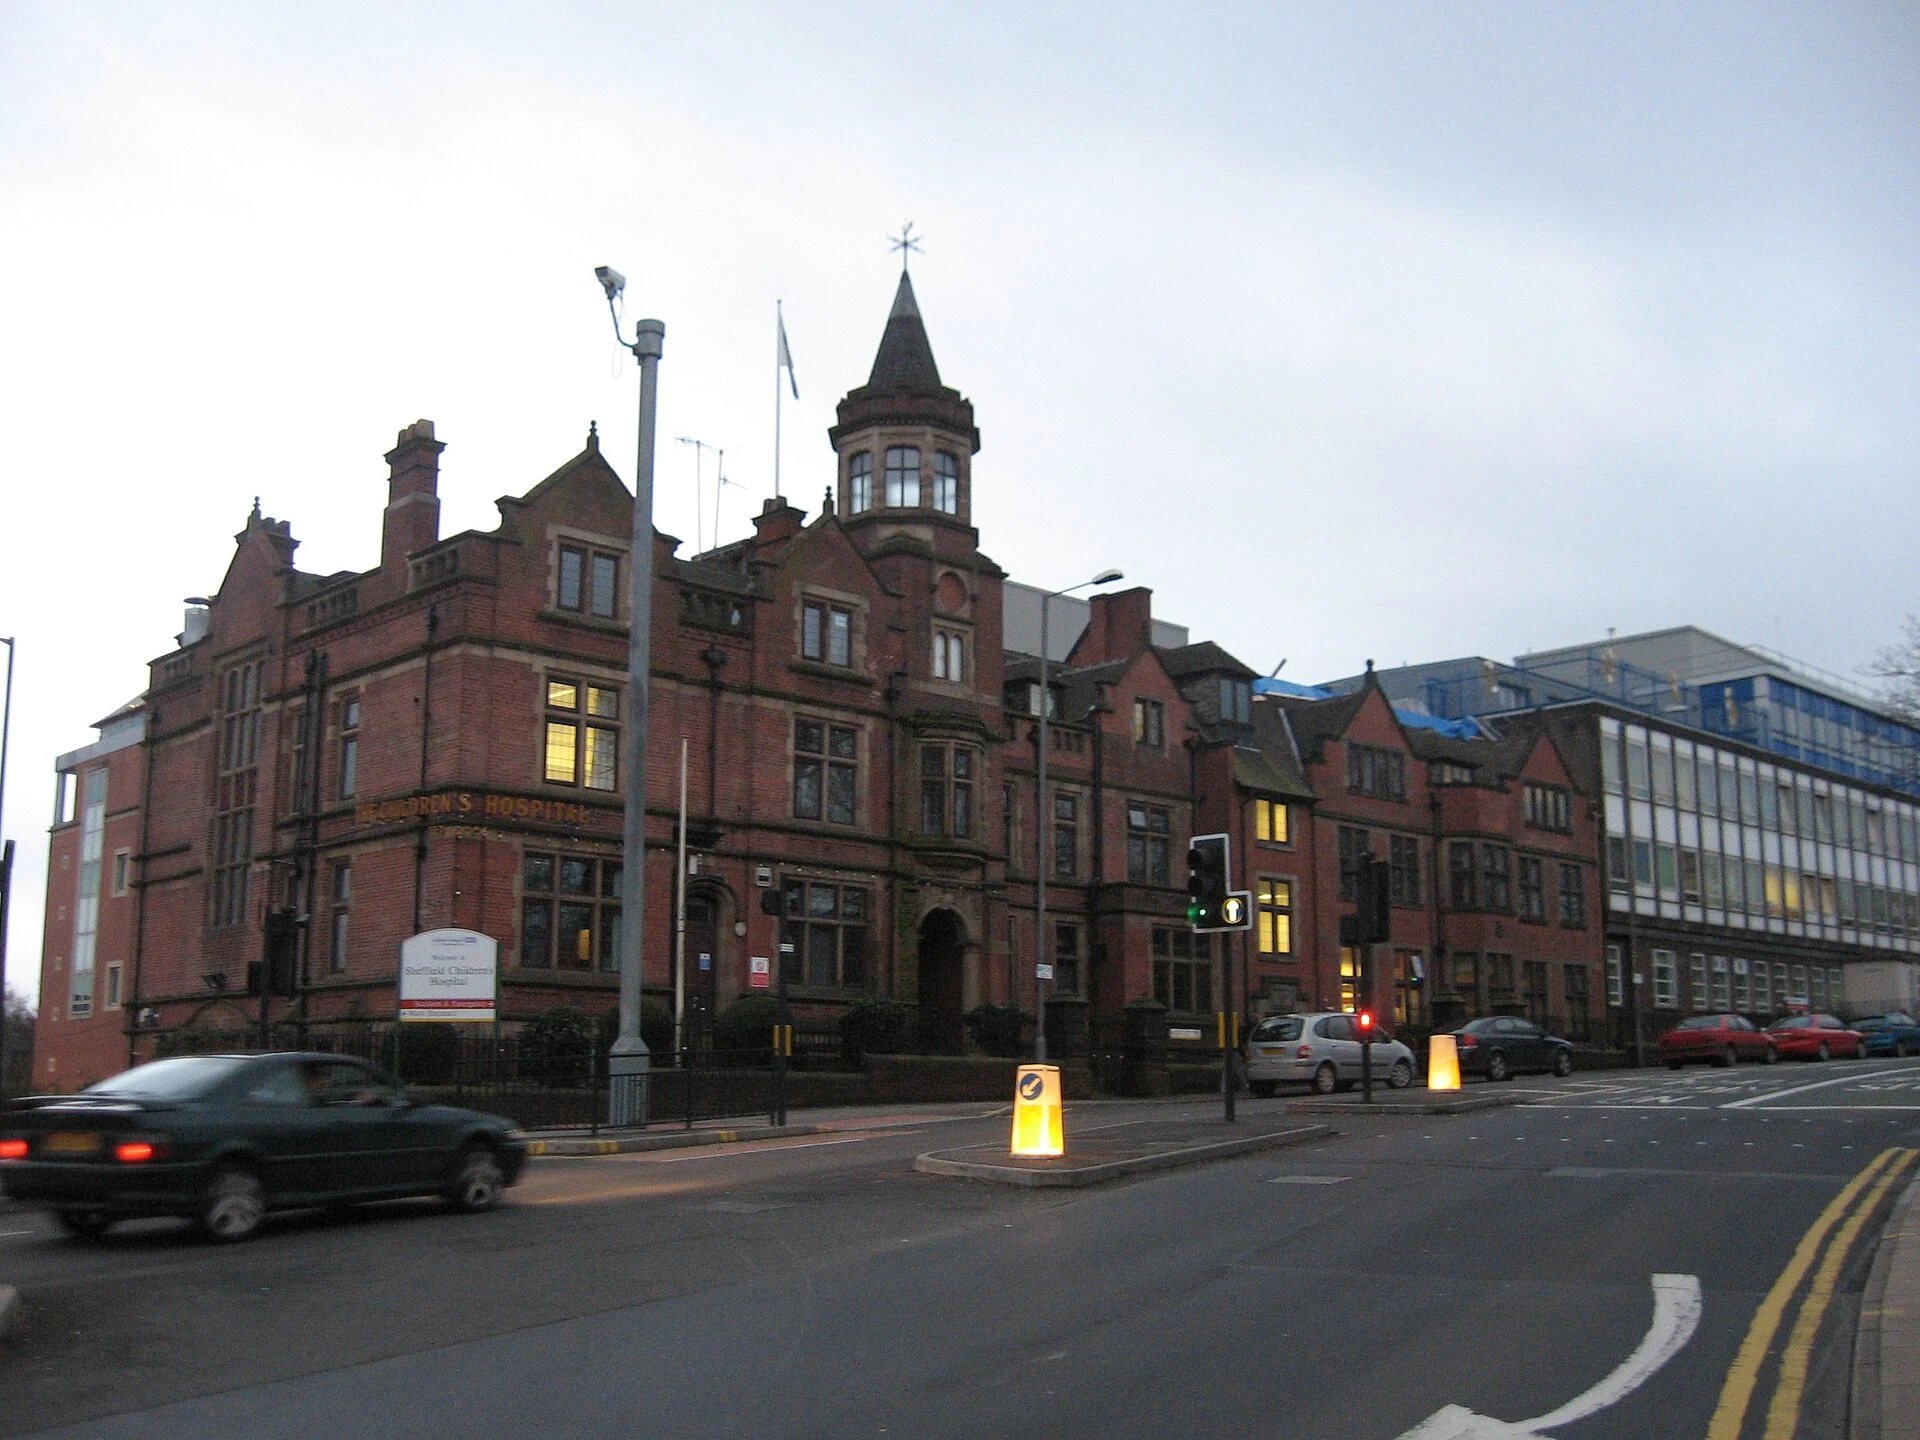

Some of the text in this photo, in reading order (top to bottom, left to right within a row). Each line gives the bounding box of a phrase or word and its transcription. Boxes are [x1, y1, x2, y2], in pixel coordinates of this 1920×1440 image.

[484, 794, 589, 824] HOSPITAL
[405, 967, 446, 976] Sheffield
[429, 977, 468, 988] Hospital
